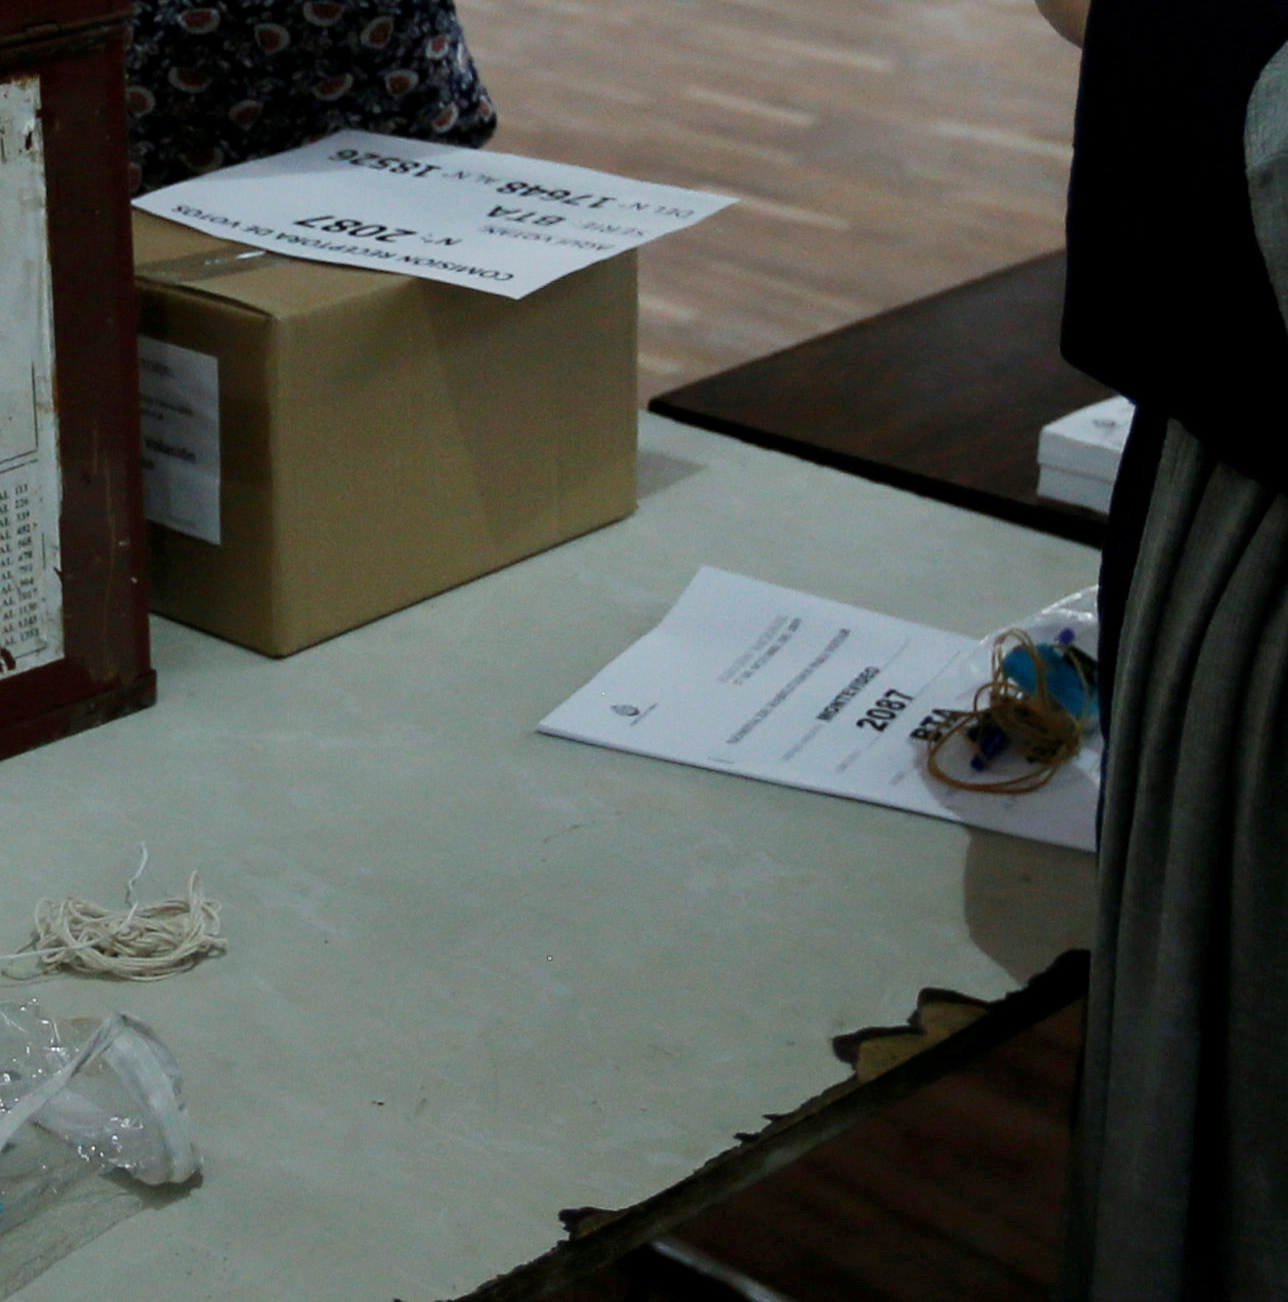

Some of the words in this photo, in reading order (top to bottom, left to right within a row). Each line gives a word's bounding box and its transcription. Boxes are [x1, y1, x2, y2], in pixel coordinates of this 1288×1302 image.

[329, 148, 442, 178] 18526
[475, 174, 503, 185] AL
[497, 181, 616, 209] 17648
[171, 204, 241, 229] VOTOS
[487, 205, 565, 227] BTA
[654, 205, 695, 219] DEL
[246, 223, 273, 237] DE
[293, 214, 417, 244] 2087
[276, 232, 392, 260] RECEPTORA
[401, 255, 516, 282] COMISION
[816, 666, 880, 722] MONTEVIDEO
[856, 688, 914, 732] 2087
